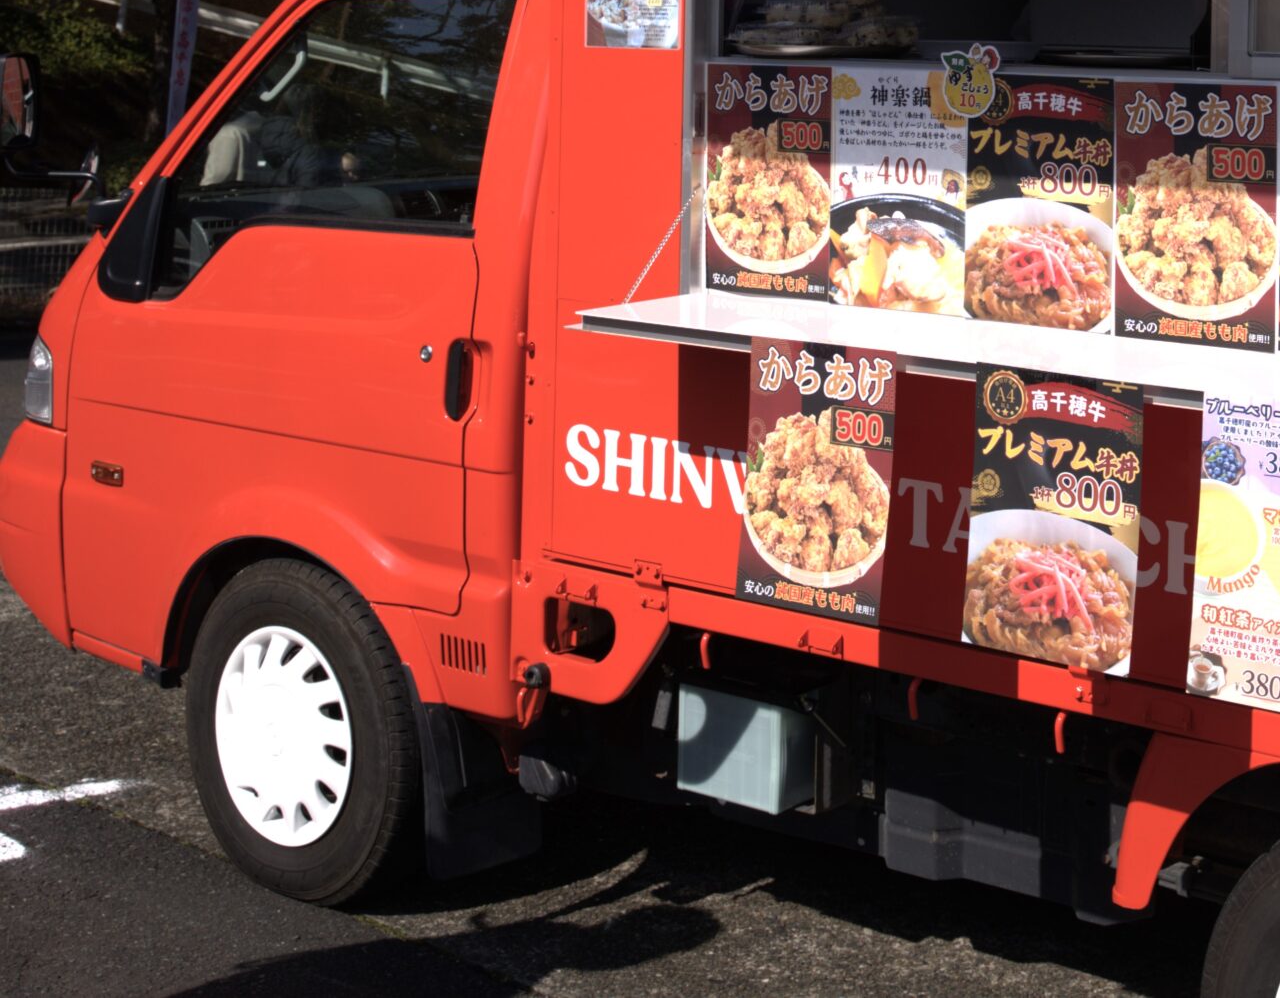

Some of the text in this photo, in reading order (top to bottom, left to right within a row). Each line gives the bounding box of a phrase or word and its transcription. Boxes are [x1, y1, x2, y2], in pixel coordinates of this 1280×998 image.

[714, 72, 828, 115] からあげ
[870, 85, 931, 108] 神楽鍋
[1017, 91, 1083, 116] 高千穂牛
[1125, 90, 1272, 141] からあげ
[970, 127, 1113, 167] プレミアム牛丼
[758, 347, 892, 405] からあげ
[995, 387, 1015, 403] A4
[1031, 389, 1106, 423] 高千穂牛
[978, 426, 1140, 484] プレミアム牛丼
[1207, 564, 1260, 594] Mango
